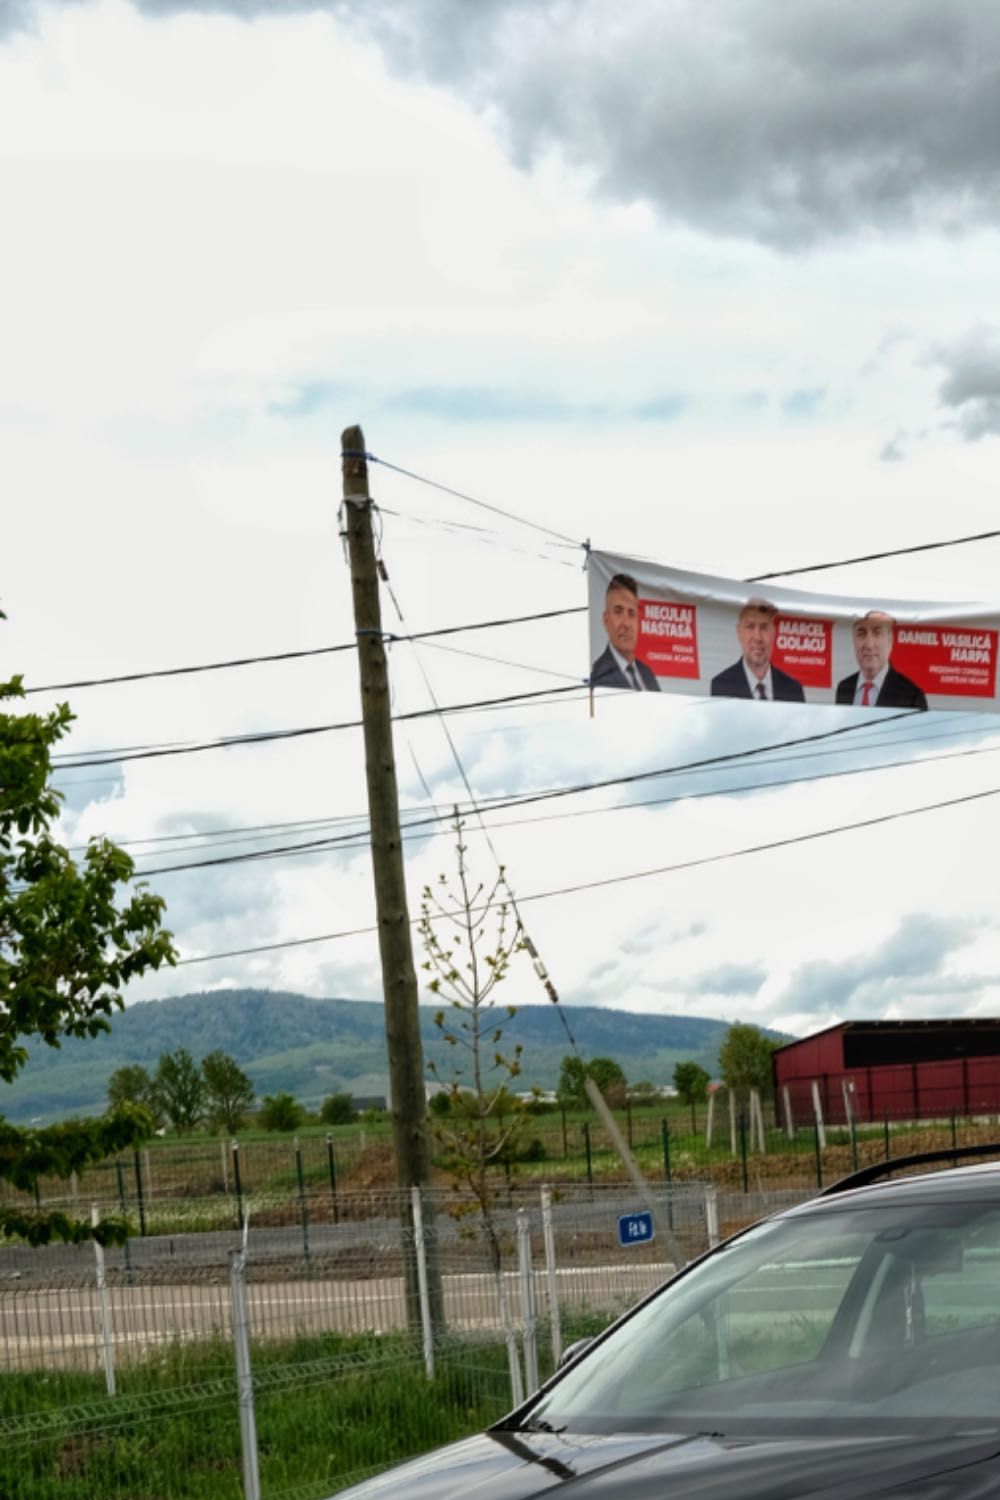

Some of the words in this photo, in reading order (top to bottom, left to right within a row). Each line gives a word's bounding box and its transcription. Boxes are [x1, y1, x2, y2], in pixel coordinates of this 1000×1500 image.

[779, 621, 826, 637] MARCEL
[776, 636, 826, 653] CIOLACU
[897, 630, 939, 646] DANIEL
[941, 632, 991, 649] VASILICĂ
[950, 648, 990, 664] HARPA
